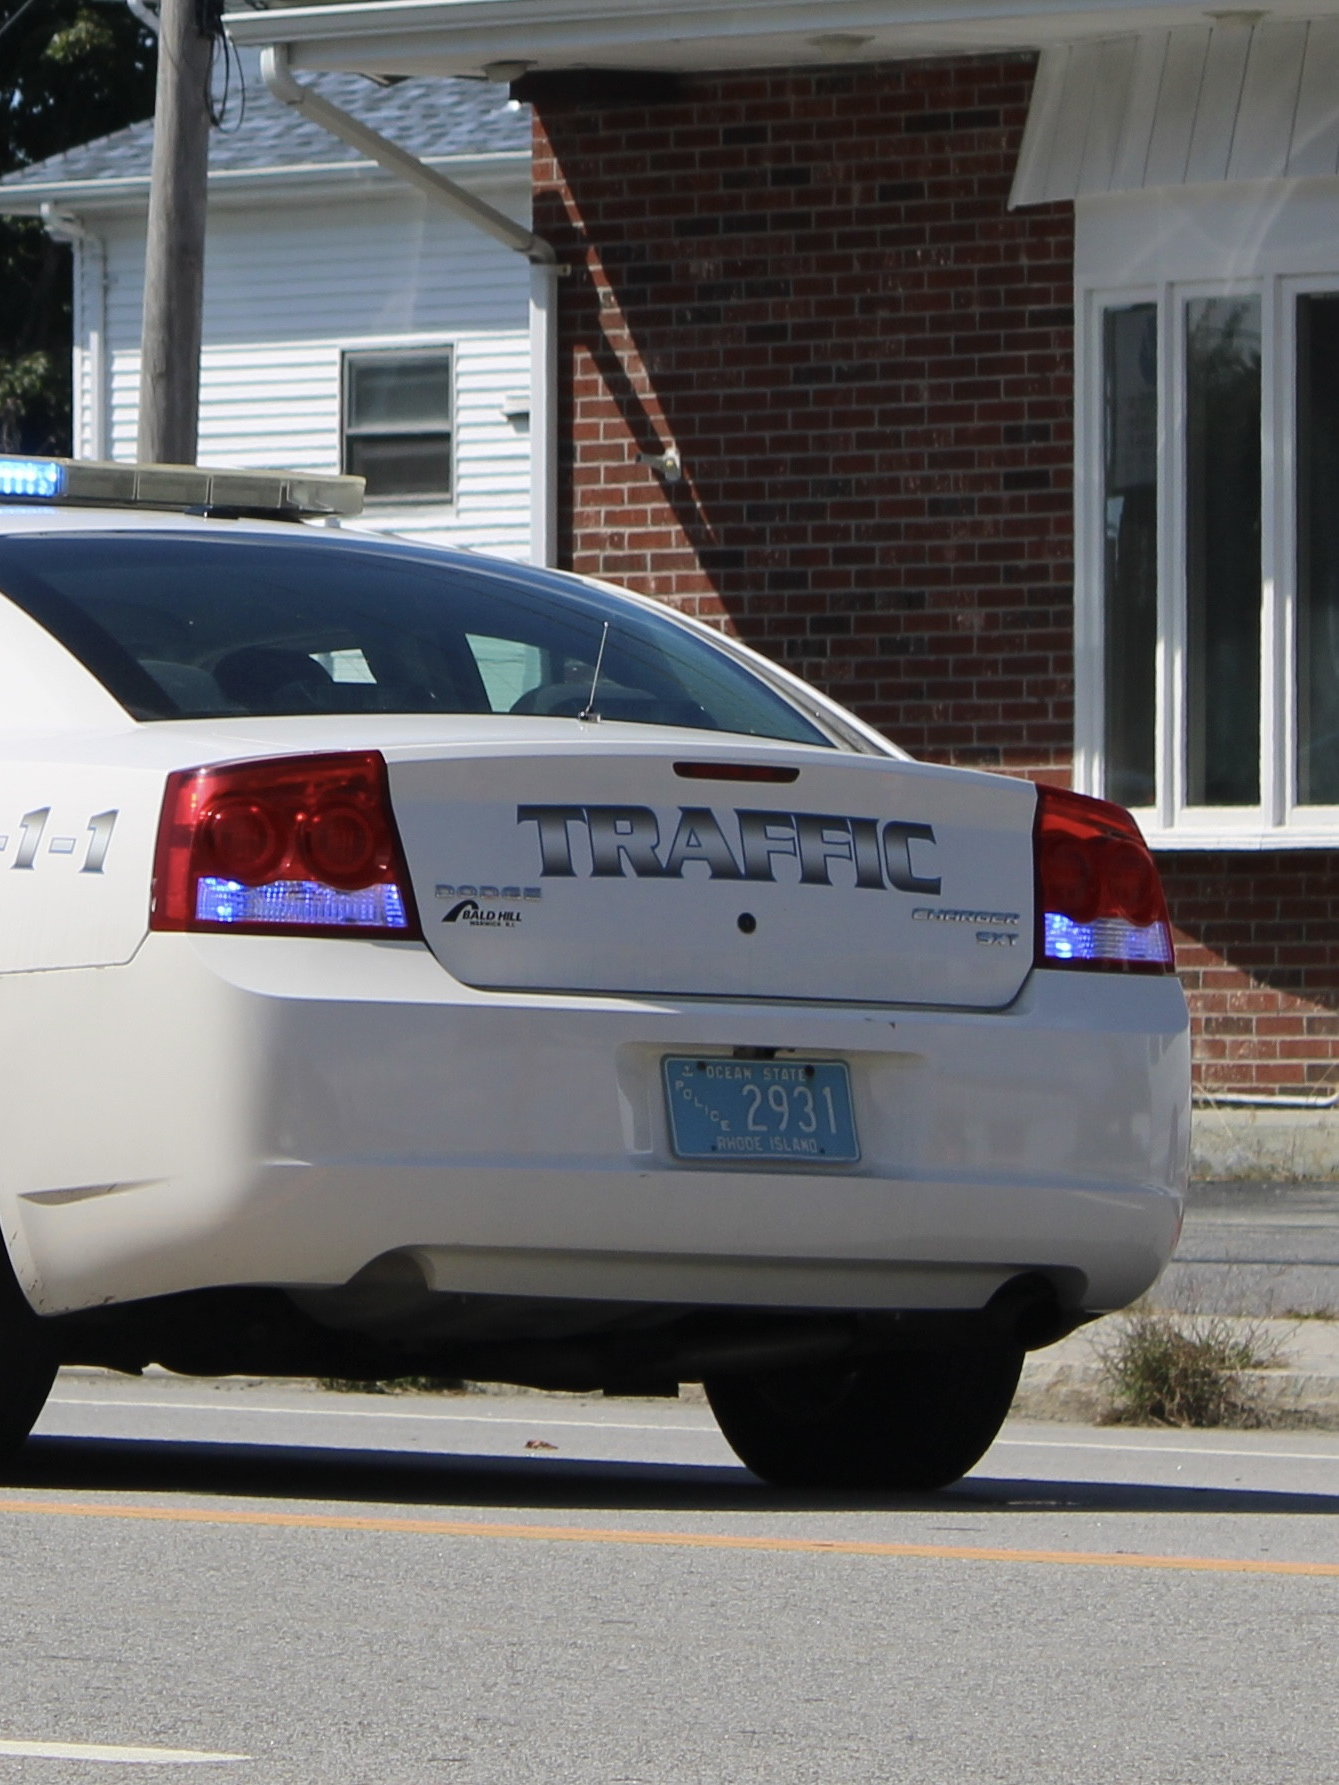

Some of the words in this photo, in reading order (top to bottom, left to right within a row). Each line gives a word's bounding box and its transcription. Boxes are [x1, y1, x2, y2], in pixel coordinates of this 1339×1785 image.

[517, 803, 942, 896] TRAFFIC
[435, 884, 542, 900] DODGE
[462, 909, 496, 920] BALD
[498, 911, 523, 922] HILL
[912, 907, 1020, 925] CHARGER
[975, 931, 1020, 946] SXT
[705, 1065, 752, 1079] OCEAN
[763, 1067, 808, 1082] STATE
[742, 1083, 838, 1134] 2931
[716, 1136, 763, 1151] RHODE
[769, 1136, 818, 1153] ISLAND
